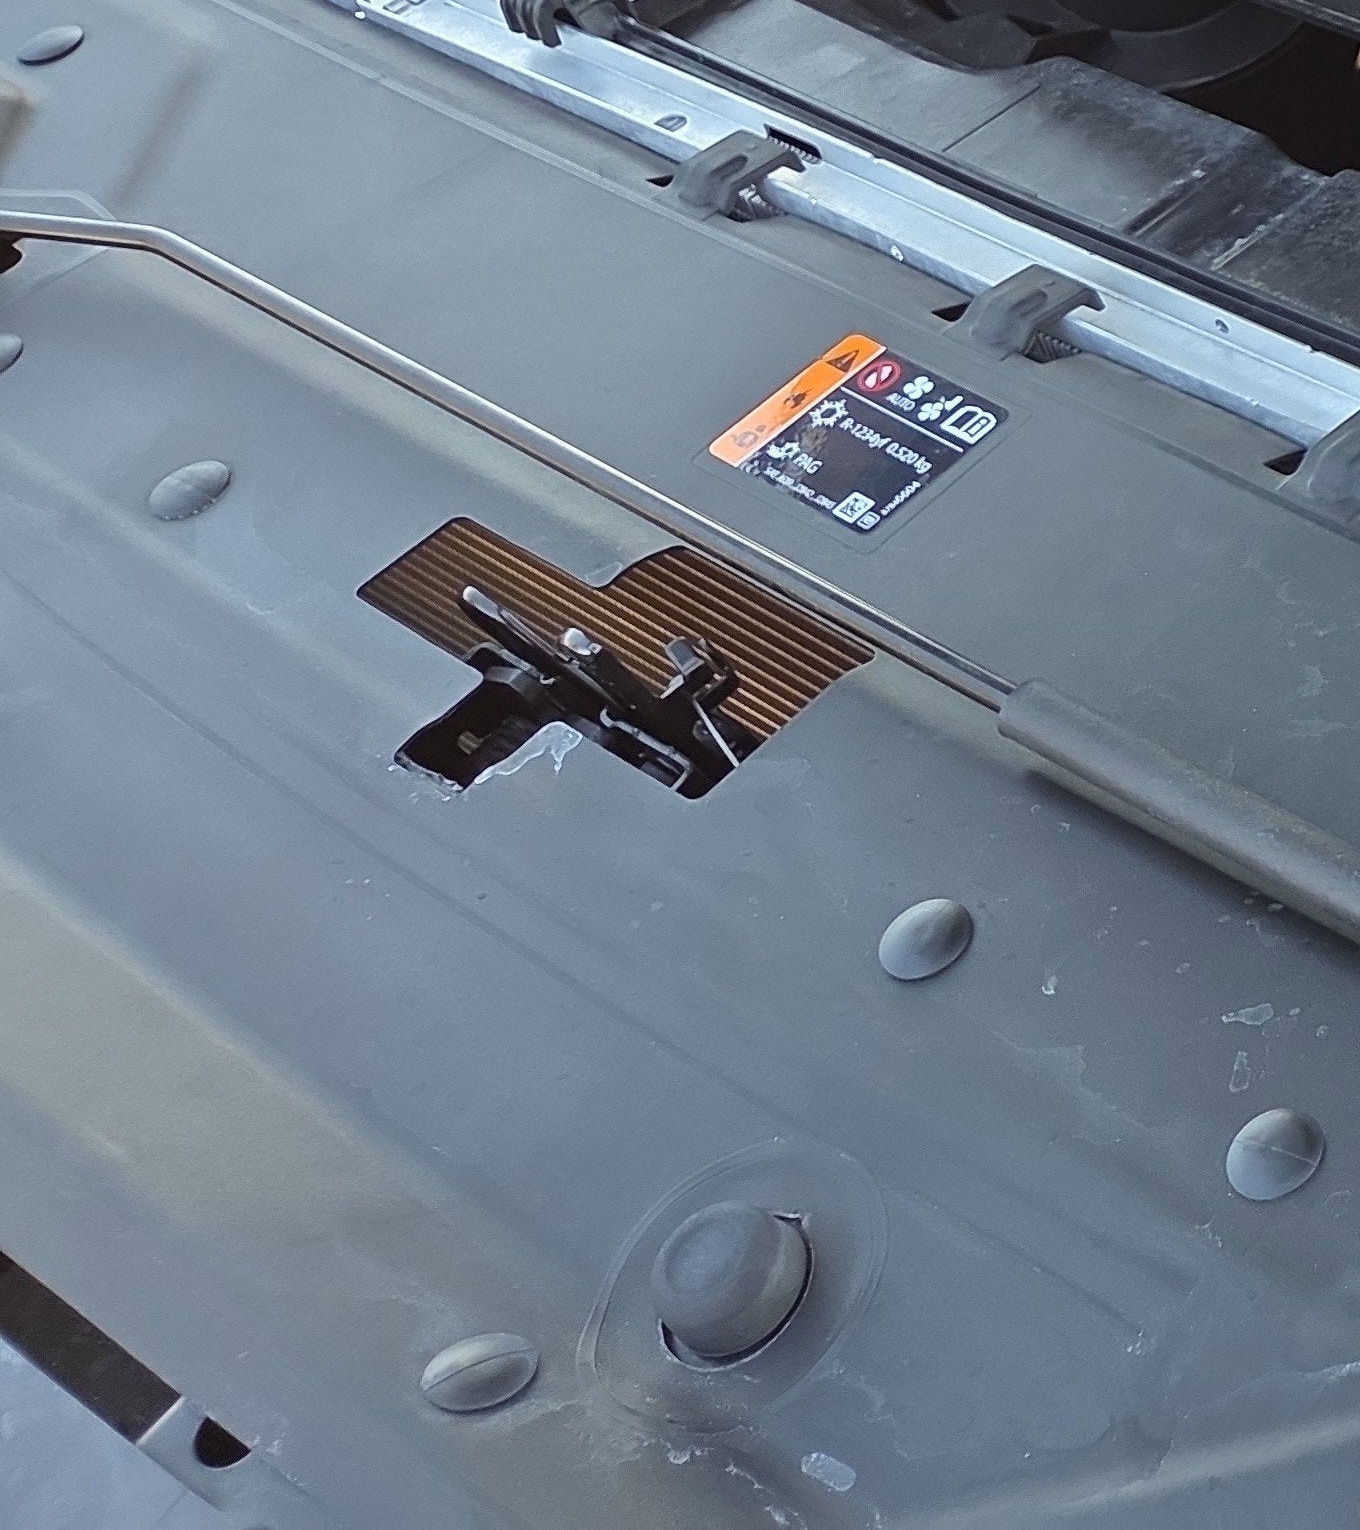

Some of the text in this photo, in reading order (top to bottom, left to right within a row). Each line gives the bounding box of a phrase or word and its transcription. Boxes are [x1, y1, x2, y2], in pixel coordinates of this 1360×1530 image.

[885, 392, 916, 411] AUTO
[797, 452, 823, 474] PAG
[914, 456, 933, 474] kg
